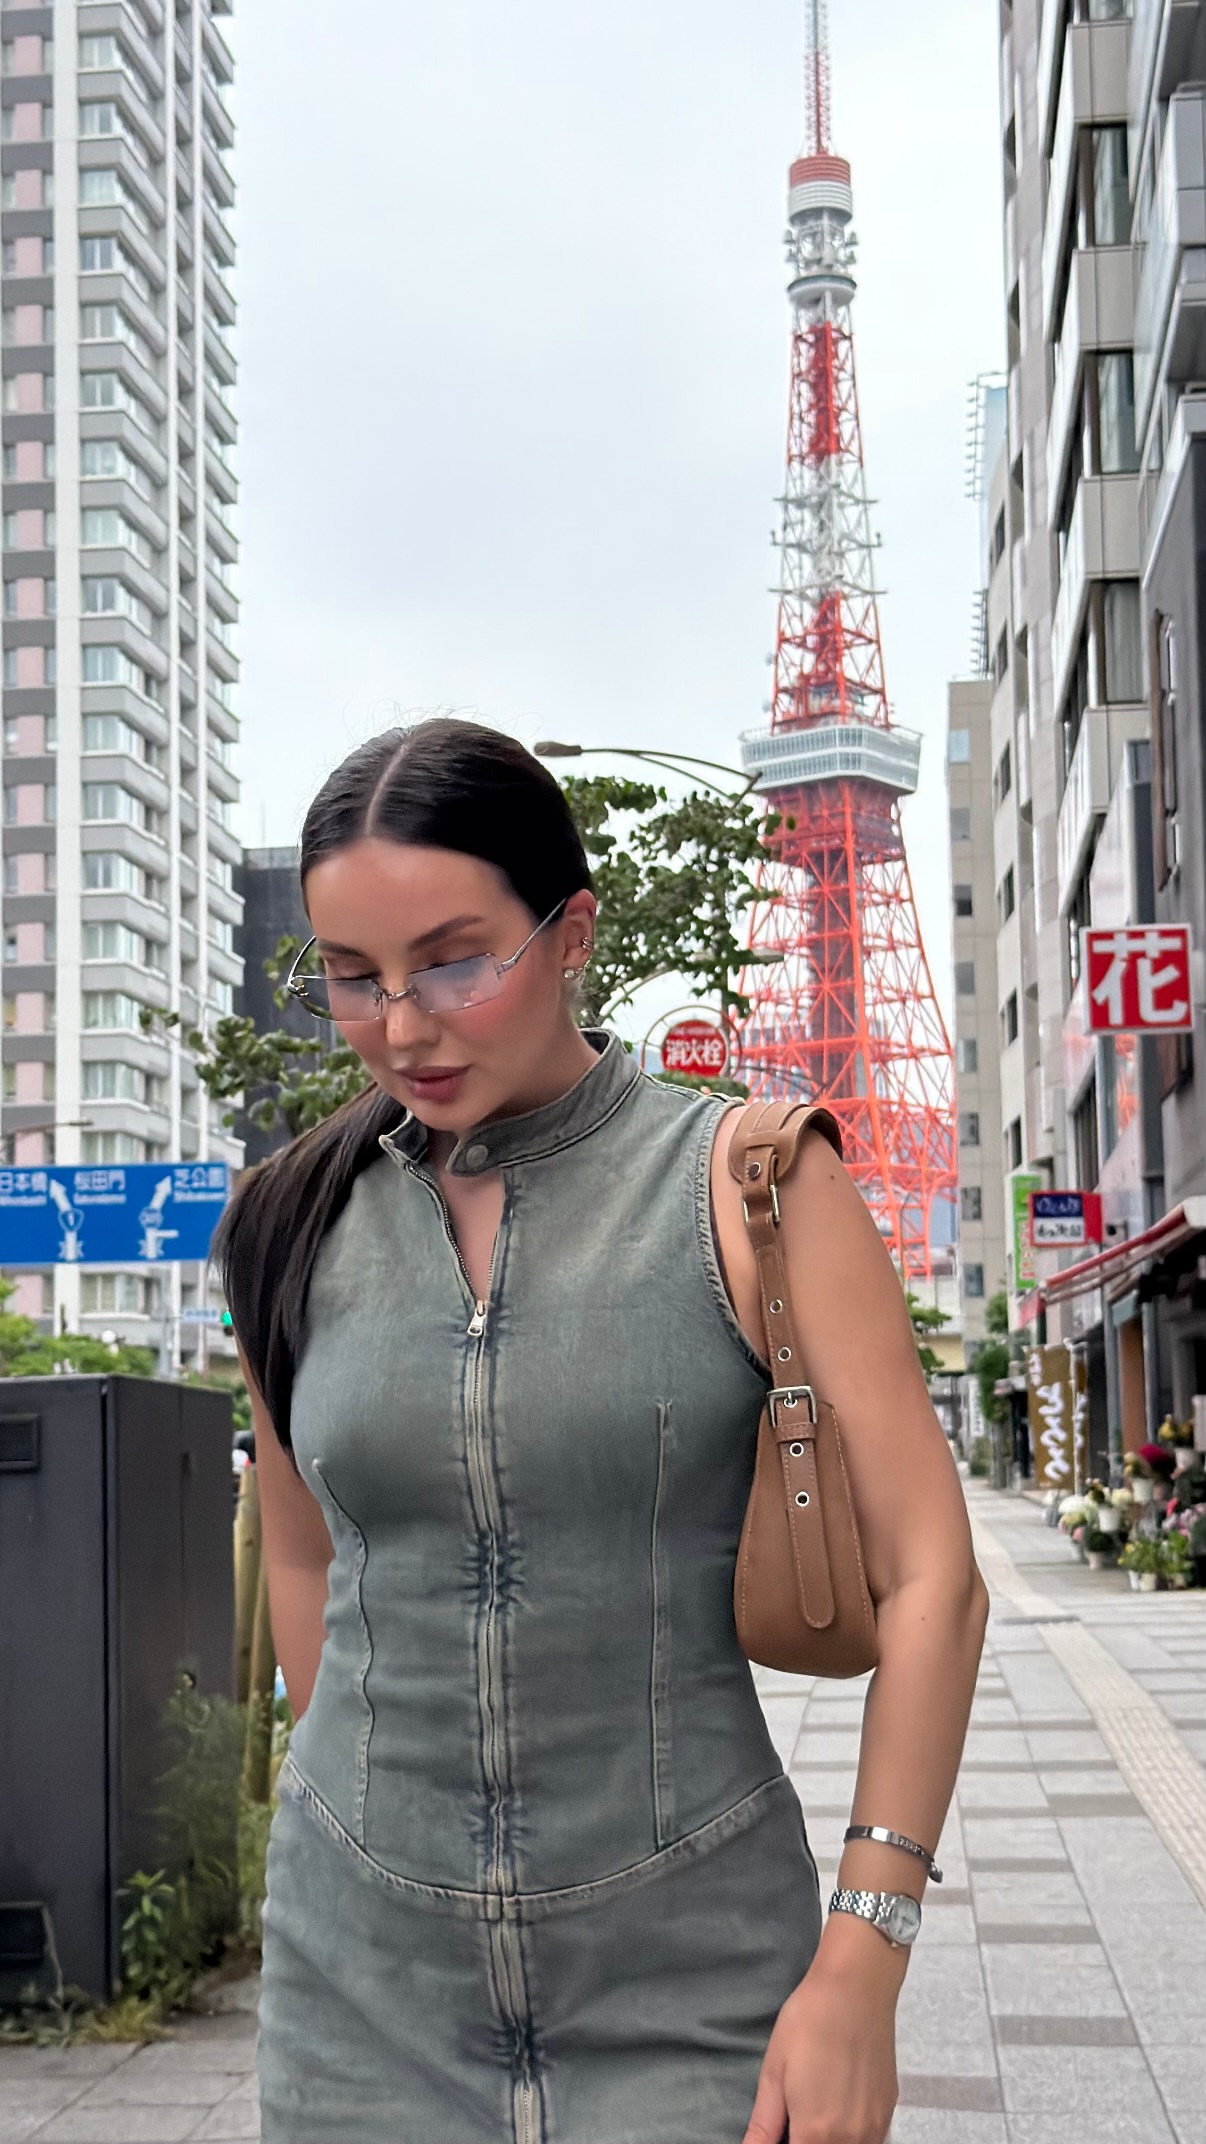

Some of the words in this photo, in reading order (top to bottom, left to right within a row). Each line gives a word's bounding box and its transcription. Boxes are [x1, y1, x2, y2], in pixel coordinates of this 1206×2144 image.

[1092, 931, 1187, 1025] 花
[666, 1038, 724, 1066] 消火栓
